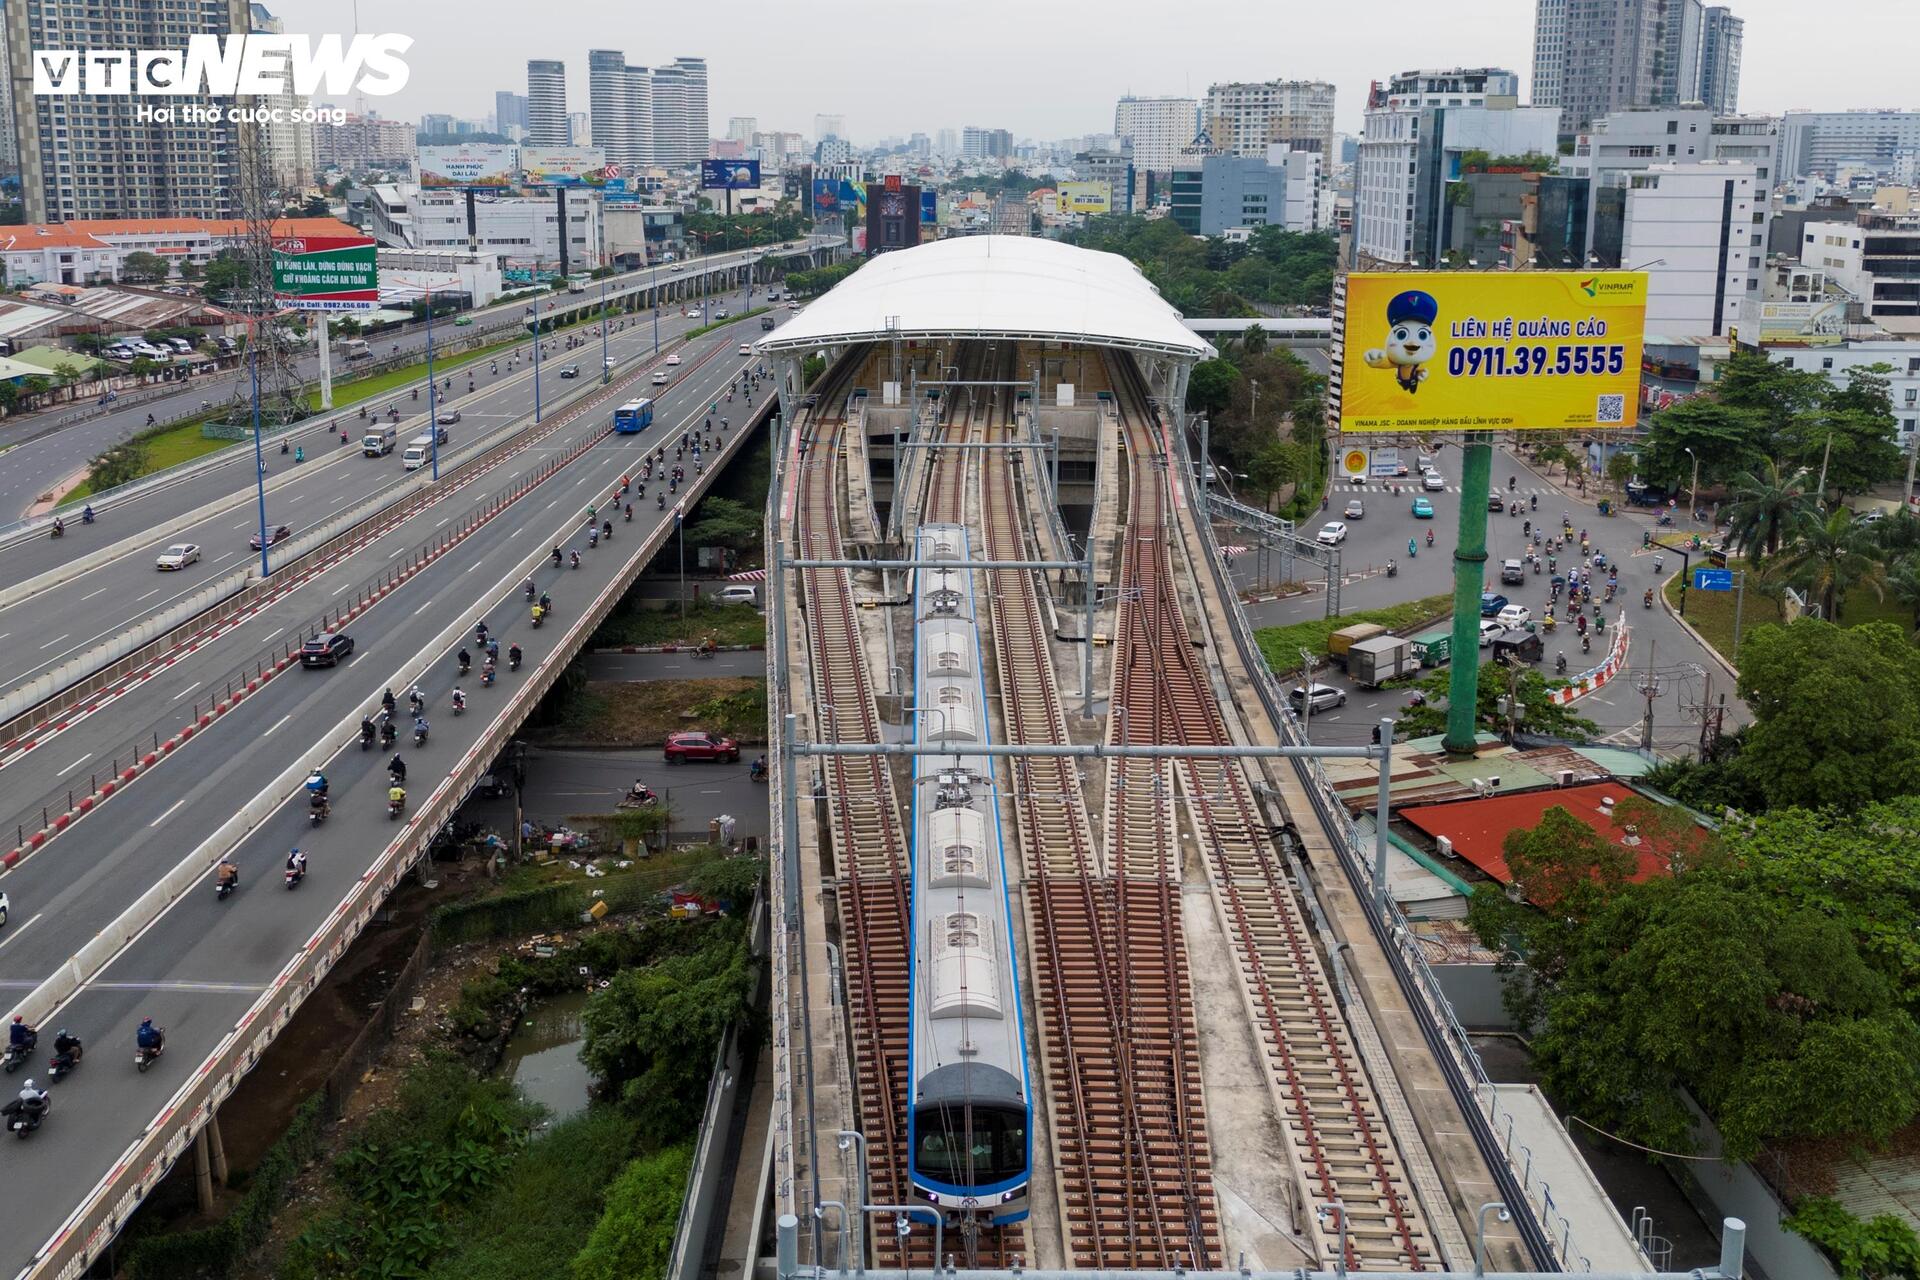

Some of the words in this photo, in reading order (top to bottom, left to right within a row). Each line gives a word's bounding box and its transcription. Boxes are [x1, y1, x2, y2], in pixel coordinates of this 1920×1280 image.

[321, 274, 339, 284] CÁCH
[340, 275, 350, 284] AN
[350, 274, 367, 284] TOÀN
[1451, 318, 1487, 337] LIÊN
[1492, 318, 1512, 341] HỆ
[1517, 316, 1571, 339] QUẢNG
[1576, 316, 1607, 337] CÁO
[1448, 345, 1625, 377] 0911.39.5555
